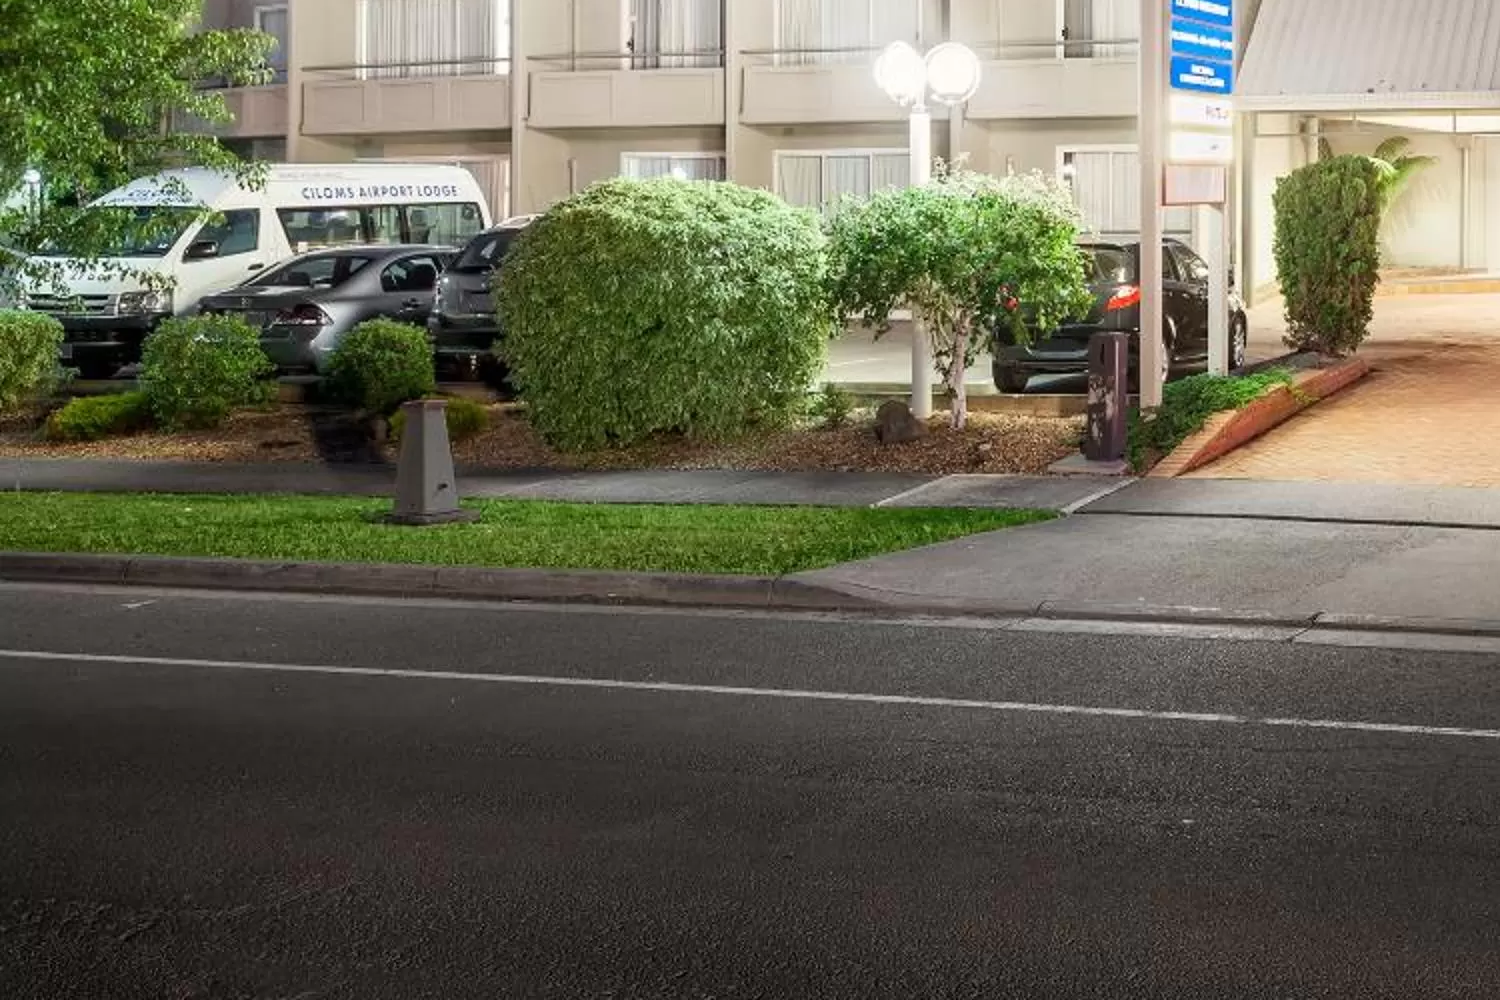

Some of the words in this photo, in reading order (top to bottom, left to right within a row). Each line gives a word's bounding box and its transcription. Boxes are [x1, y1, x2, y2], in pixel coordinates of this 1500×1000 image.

[301, 187, 355, 200] CILOMS
[359, 185, 413, 198] AIRPORT
[418, 185, 458, 197] LODGE
